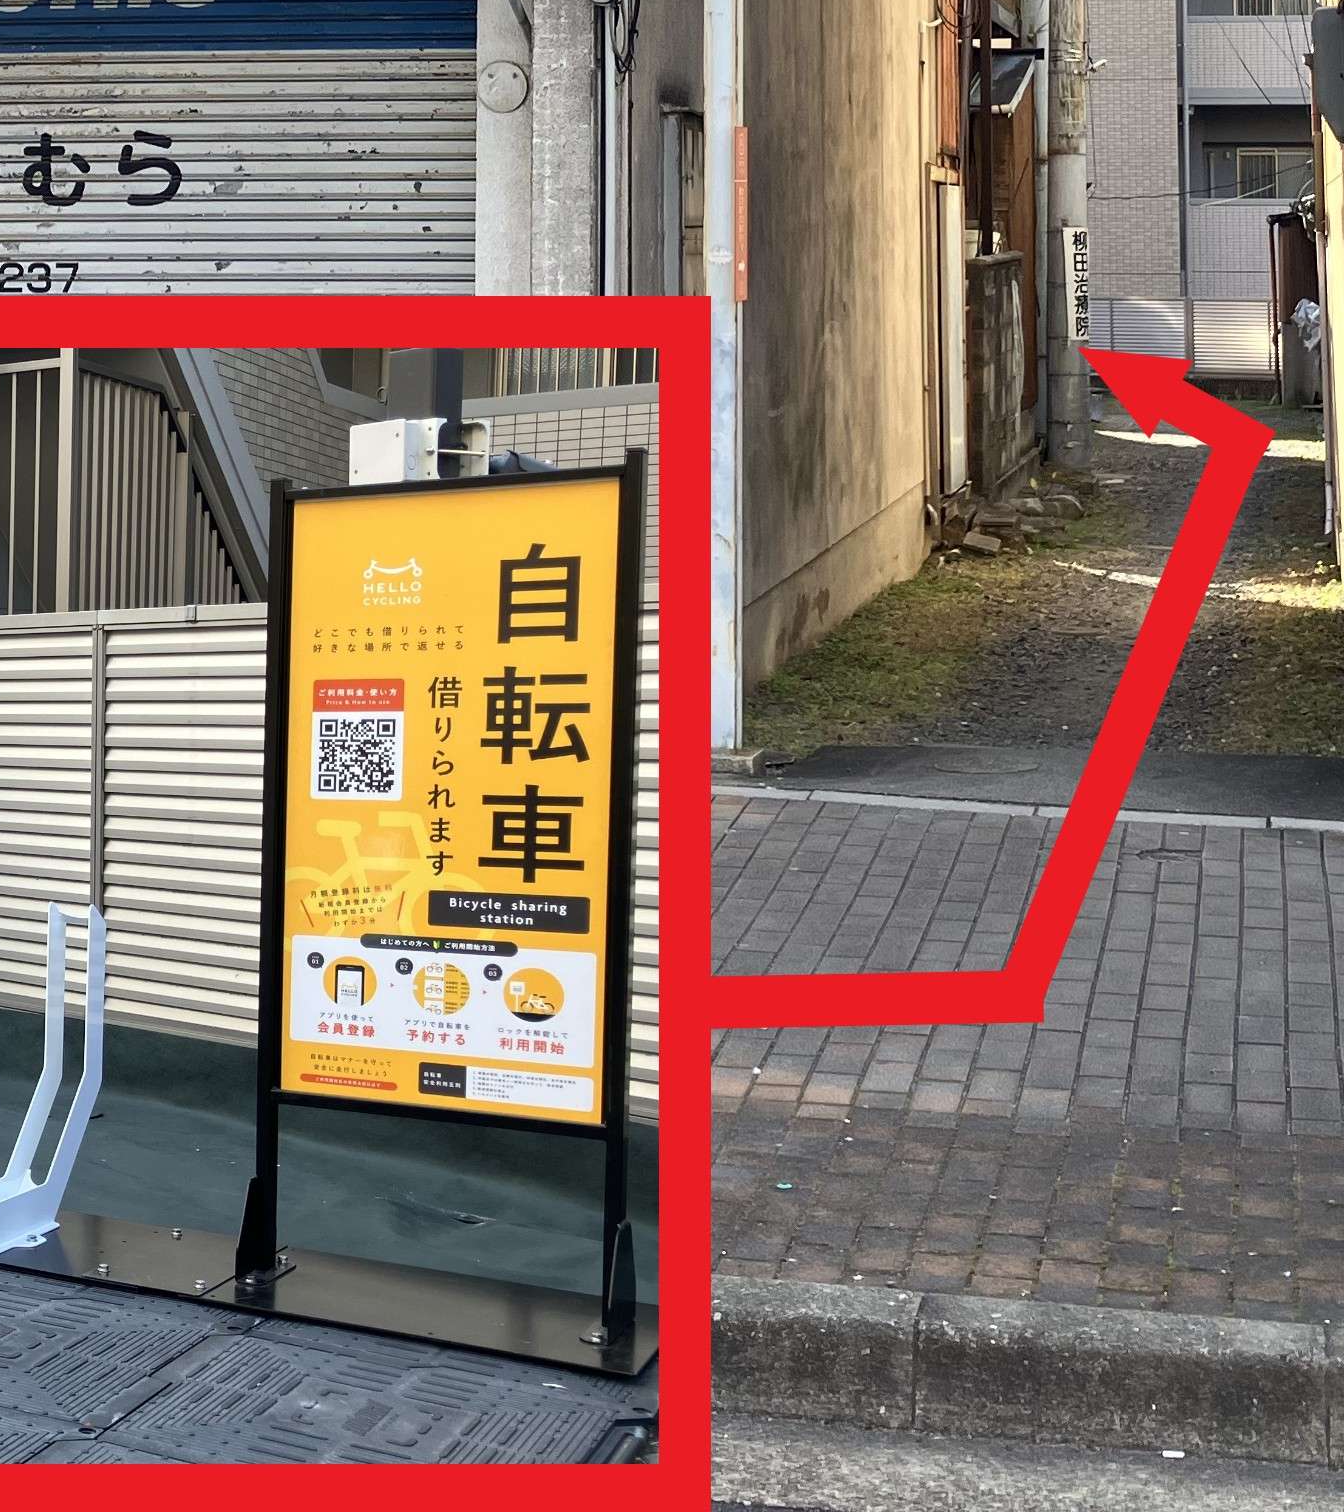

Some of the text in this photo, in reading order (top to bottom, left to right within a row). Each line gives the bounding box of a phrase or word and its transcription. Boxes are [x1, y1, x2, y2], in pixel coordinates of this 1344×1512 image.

[362, 581, 422, 594] HELLO
[362, 595, 422, 606] CYCLING
[313, 625, 465, 638] どこでも借りられて
[312, 640, 464, 653] 好きな場所で返せる
[477, 541, 592, 884] 自転車
[425, 674, 463, 878] 借りられます
[449, 897, 568, 916] Bicycle sharing
[479, 914, 534, 925] station
[380, 938, 430, 948] はじめての方へ
[320, 1012, 374, 1022] アプリを使って
[317, 1021, 375, 1038] 会員登録
[404, 1019, 471, 1031] アプリで自転車を
[405, 1029, 466, 1046] 予約する
[499, 1037, 566, 1055] 利用開始
